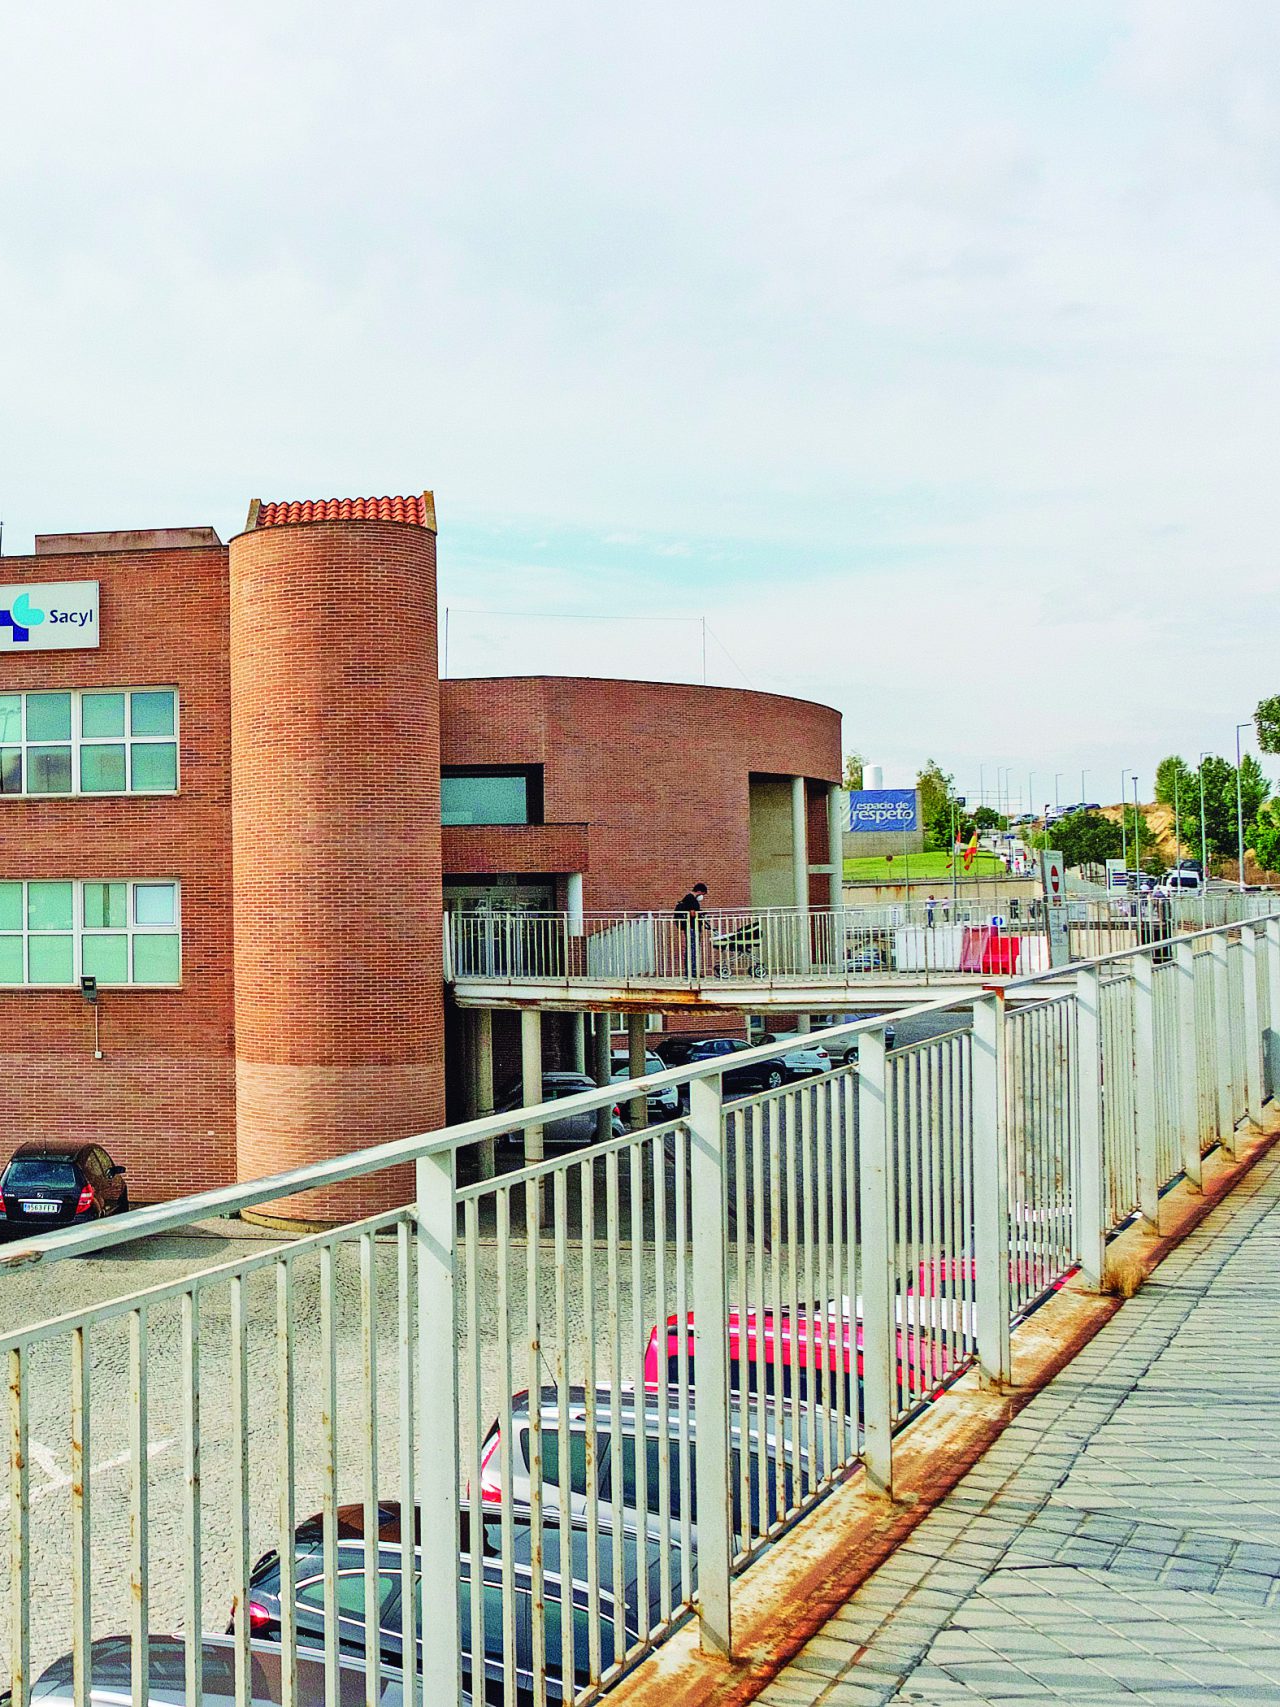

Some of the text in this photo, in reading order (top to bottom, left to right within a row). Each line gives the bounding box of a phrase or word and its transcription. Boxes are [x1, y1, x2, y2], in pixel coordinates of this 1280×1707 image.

[49, 609, 93, 627] Sacyl
[856, 801, 909, 811] espacio de
[852, 809, 914, 823] respeto
